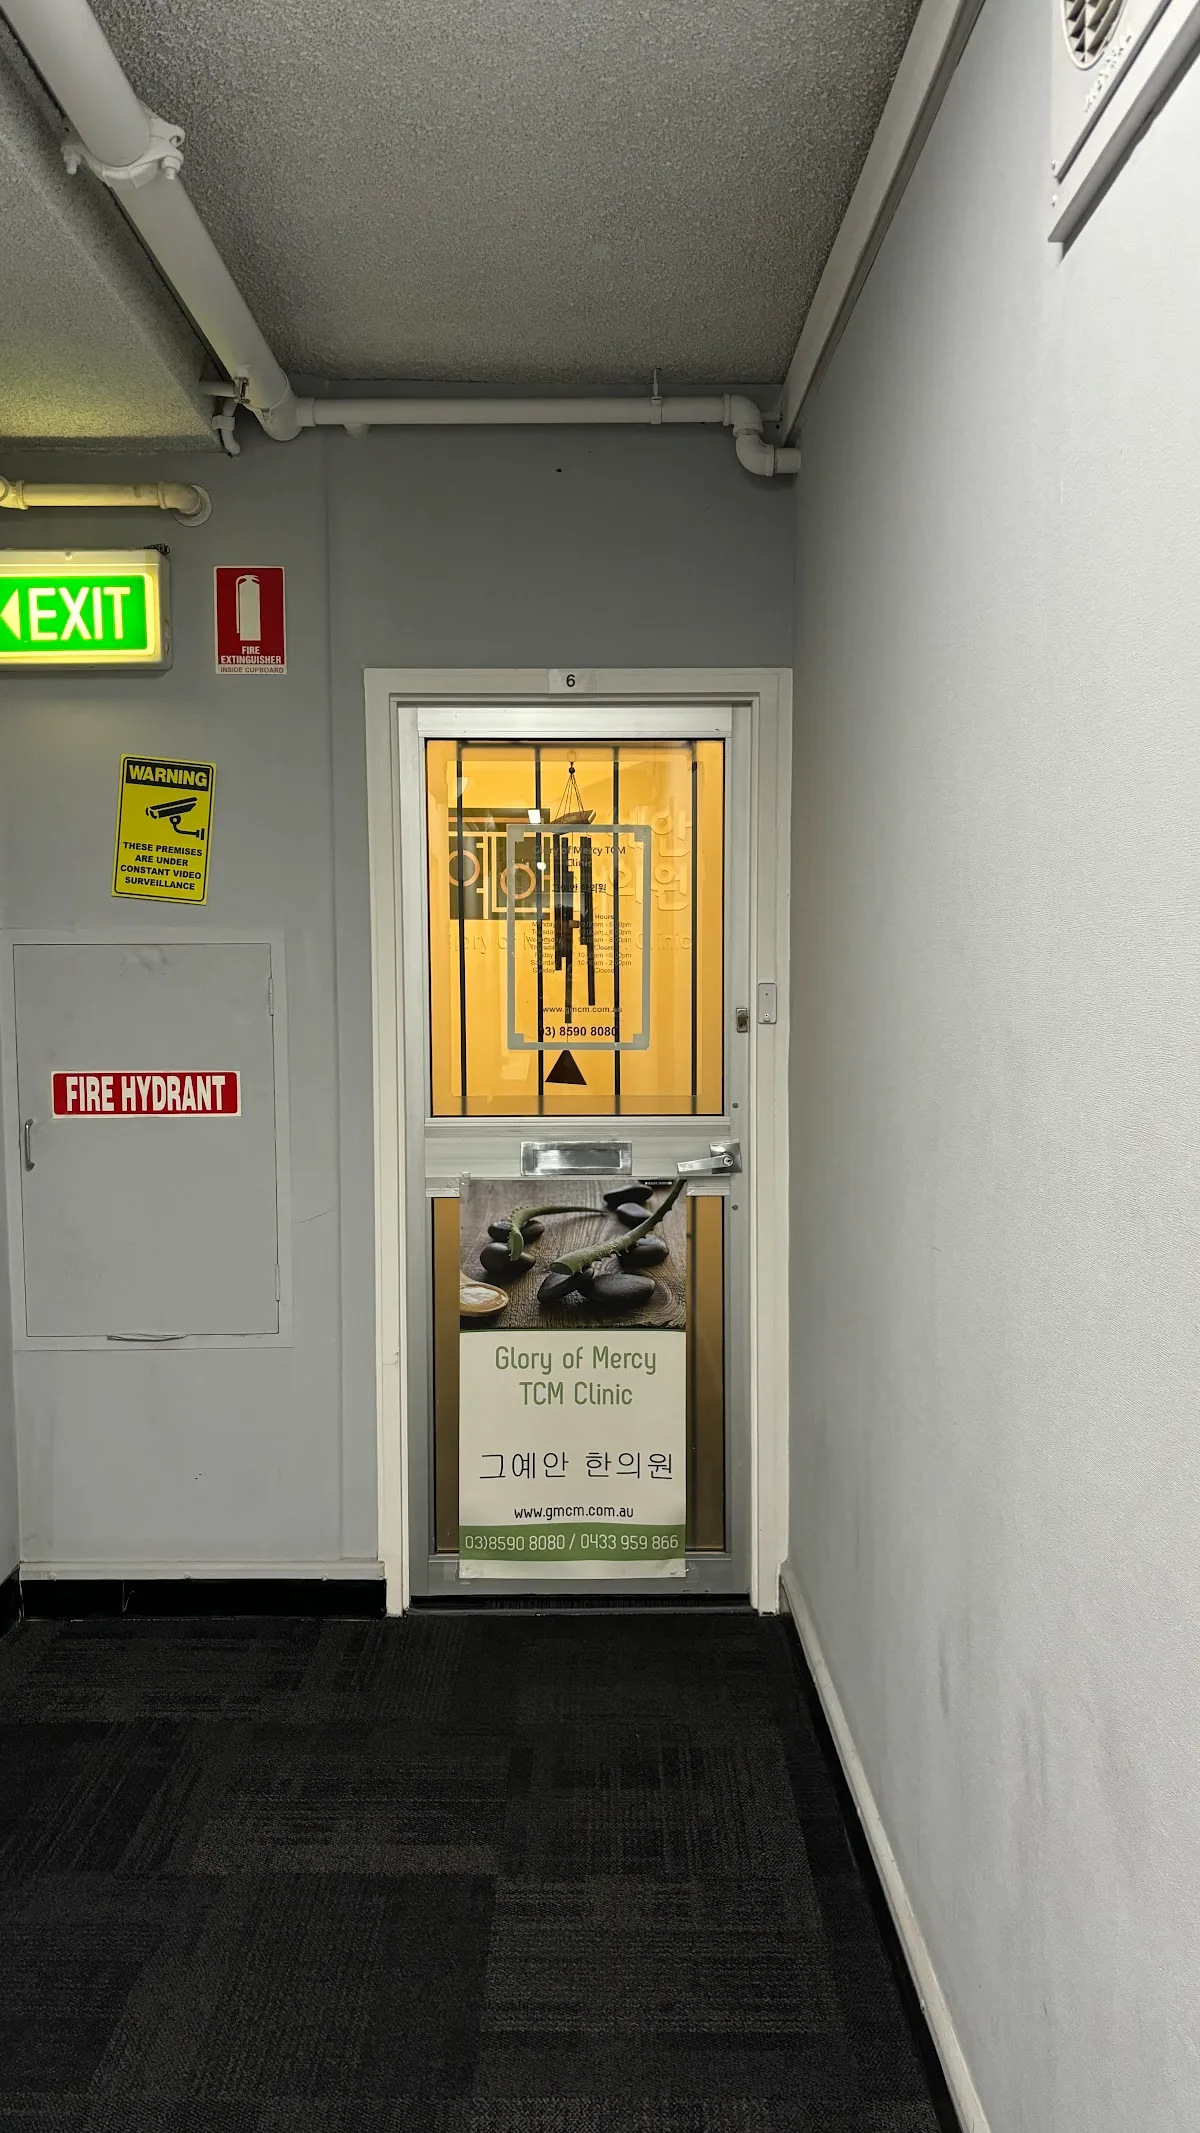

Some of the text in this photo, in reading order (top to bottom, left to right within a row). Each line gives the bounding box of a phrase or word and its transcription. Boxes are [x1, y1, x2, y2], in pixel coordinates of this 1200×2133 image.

[28, 586, 131, 641] EXIT
[242, 646, 261, 655] FIRE
[220, 656, 282, 664] EXTINGUISHER
[245, 666, 284, 674] CUPBOARD
[566, 674, 576, 688] 6
[128, 764, 208, 787] WARNING
[123, 841, 203, 857] THESE PREMISES
[536, 845, 559, 857] Gory
[605, 846, 626, 854] TCM
[134, 854, 189, 867] ARE UNDER
[120, 864, 202, 880] CONSTANT VIDEO
[124, 876, 196, 891] SURVEILLANCE
[542, 1006, 623, 1015] www.gmcm.com.au
[560, 1026, 587, 1036] 8590
[66, 1075, 226, 1112] FIRE HYDRANT
[495, 1345, 658, 1376] Glory of Mercy
[519, 1380, 634, 1406] TCM Clinic
[479, 1451, 673, 1480] 그예안 한의원
[513, 1505, 634, 1521] www.gmcm.com.au
[464, 1533, 680, 1552] 03)8590 8080 / 0433 959 866
